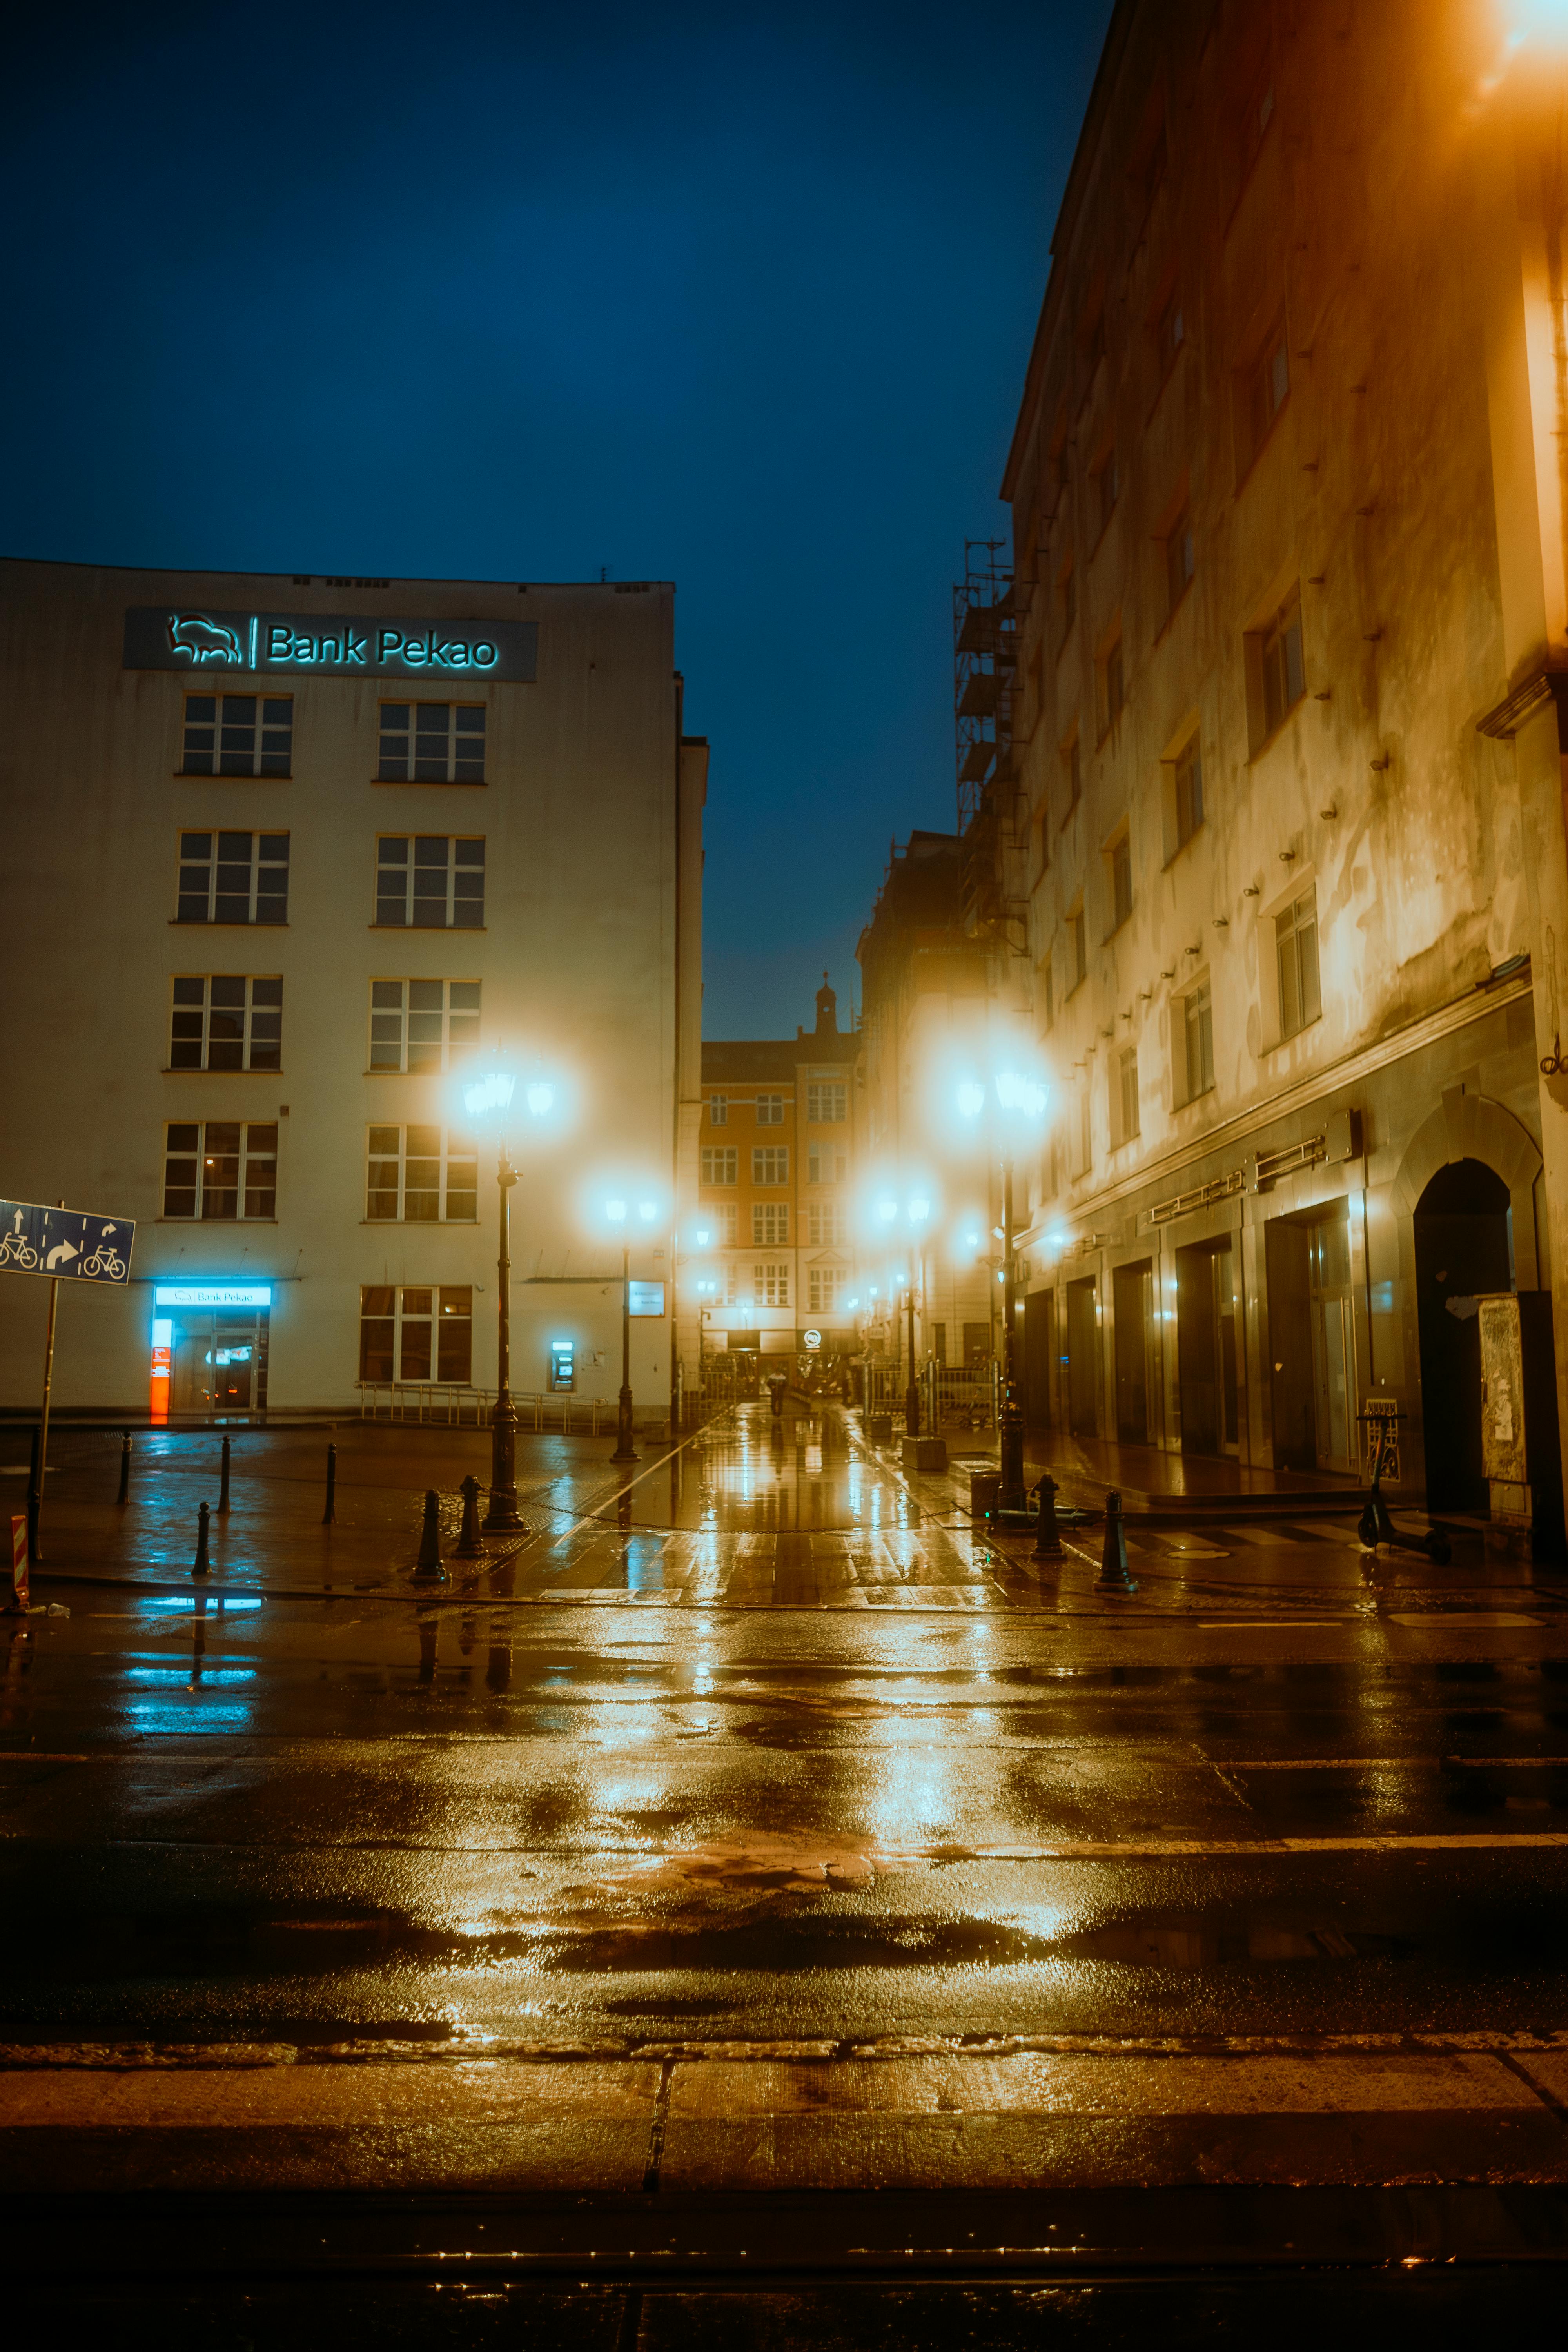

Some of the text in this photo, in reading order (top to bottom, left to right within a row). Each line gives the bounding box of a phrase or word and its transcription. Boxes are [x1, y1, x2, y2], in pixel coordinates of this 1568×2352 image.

[266, 626, 498, 668] Bank Pekao
[198, 1292, 253, 1302] Bank Pekao
